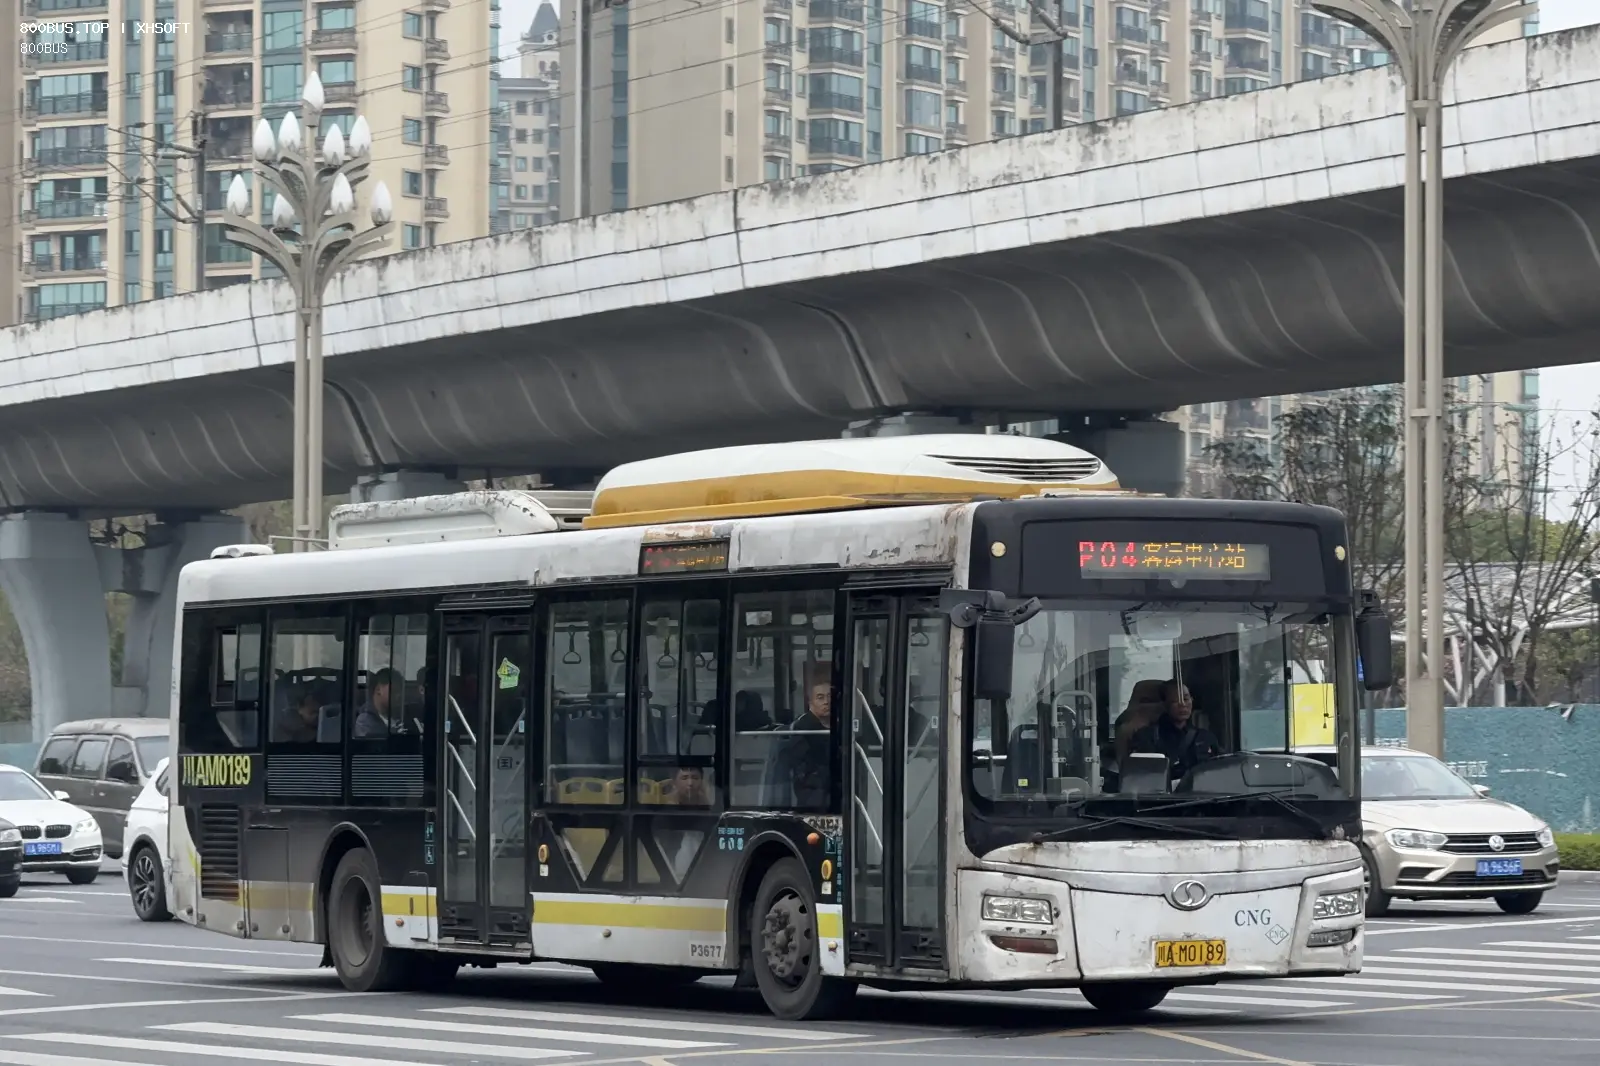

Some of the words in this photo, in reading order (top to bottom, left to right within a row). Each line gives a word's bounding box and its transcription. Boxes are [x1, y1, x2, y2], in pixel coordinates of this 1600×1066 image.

[1079, 541, 1138, 568] P04
[182, 755, 252, 786] 川AM0189
[1234, 908, 1271, 927] CNG
[1268, 930, 1286, 938] CNG
[690, 943, 722, 958] P3677
